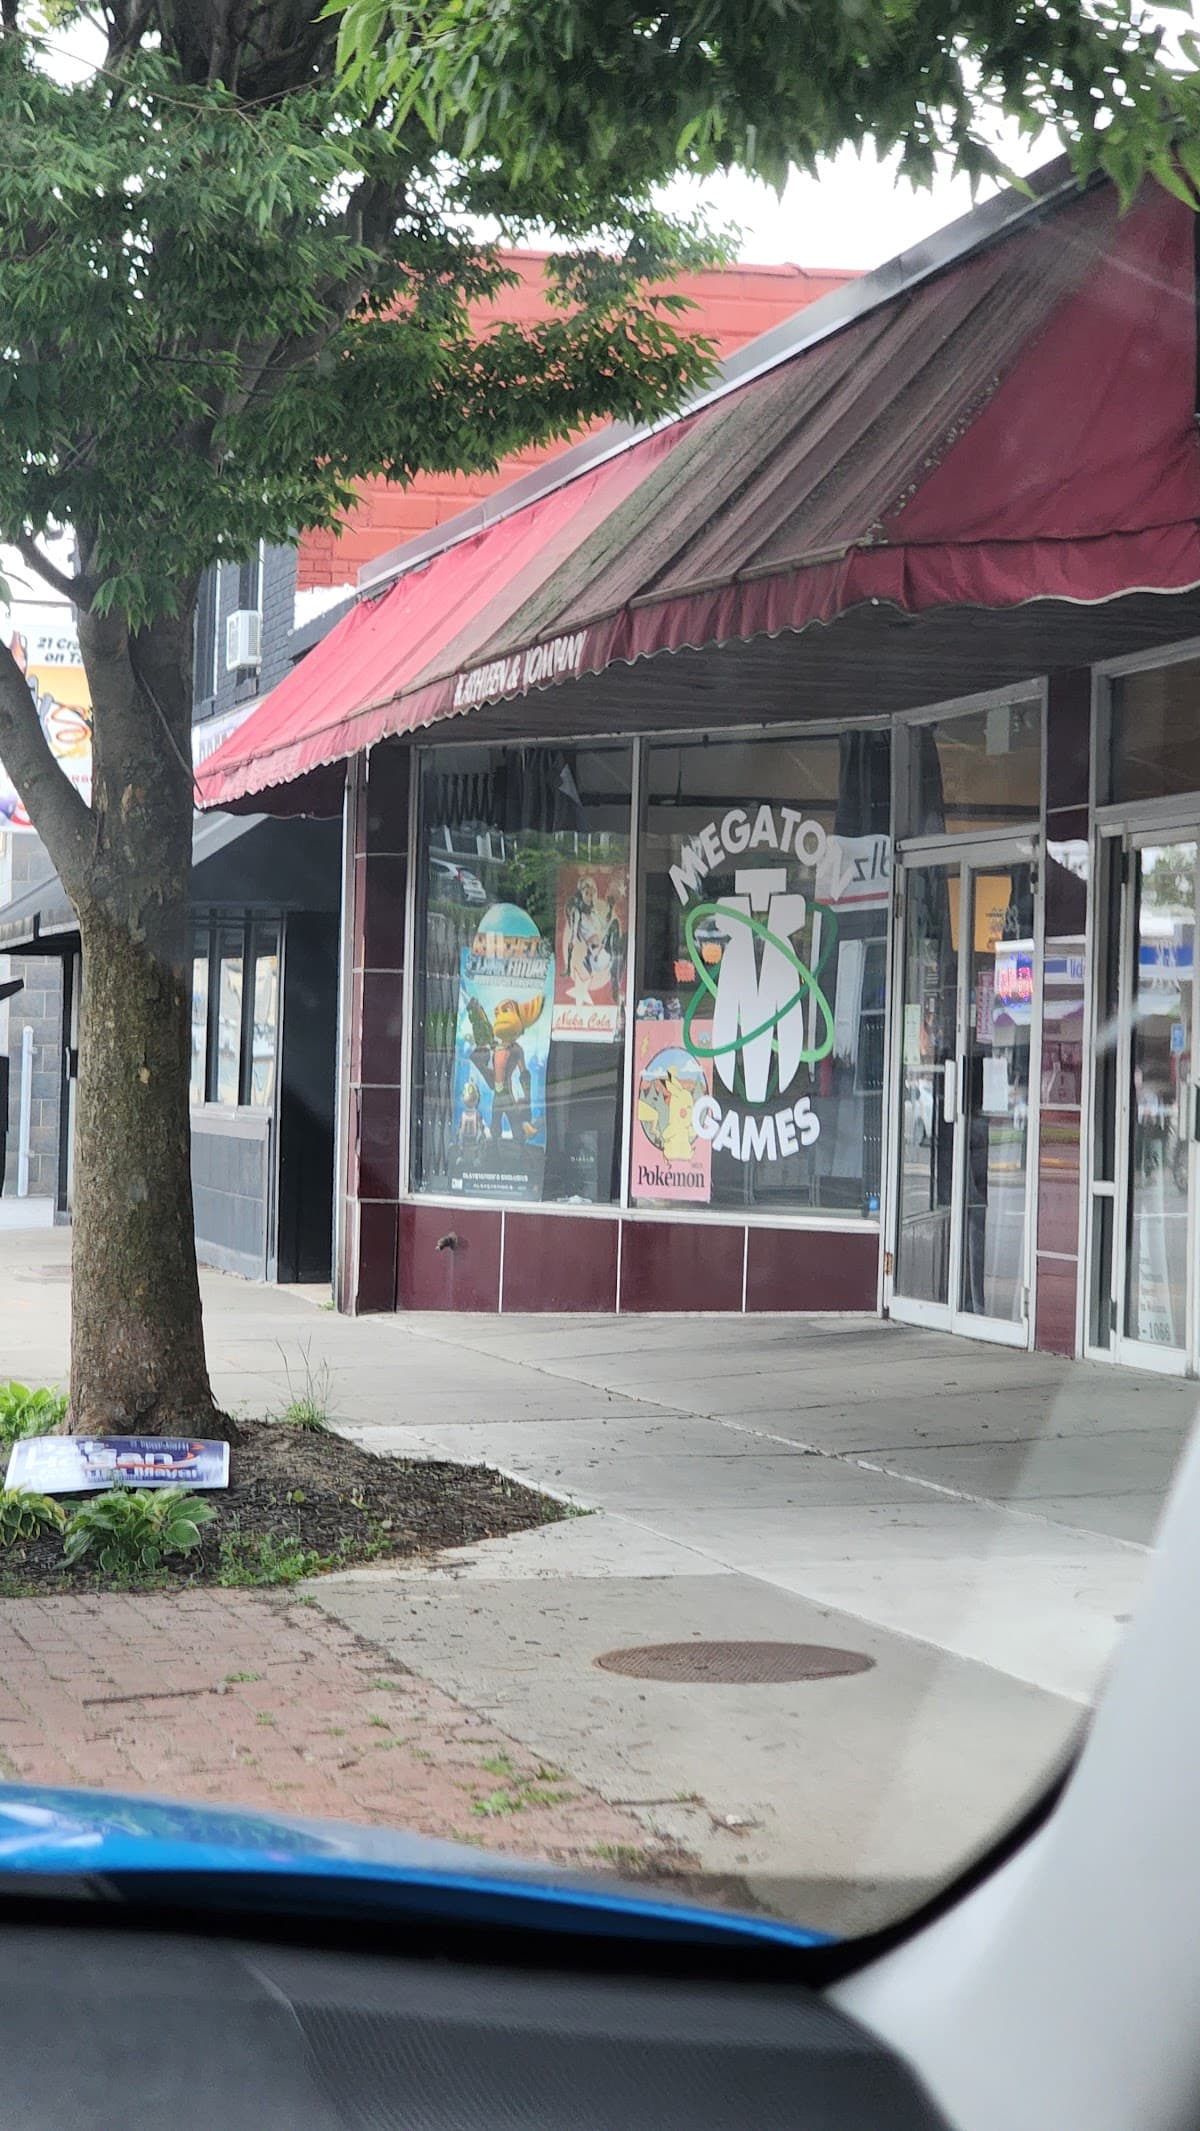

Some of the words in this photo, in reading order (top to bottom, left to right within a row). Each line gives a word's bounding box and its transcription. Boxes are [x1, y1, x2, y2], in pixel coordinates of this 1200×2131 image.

[669, 804, 855, 906] MEGATON
[588, 1011, 611, 1028] Cola
[692, 1095, 820, 1162] GAMES
[638, 1164, 705, 1188] Pokémon
